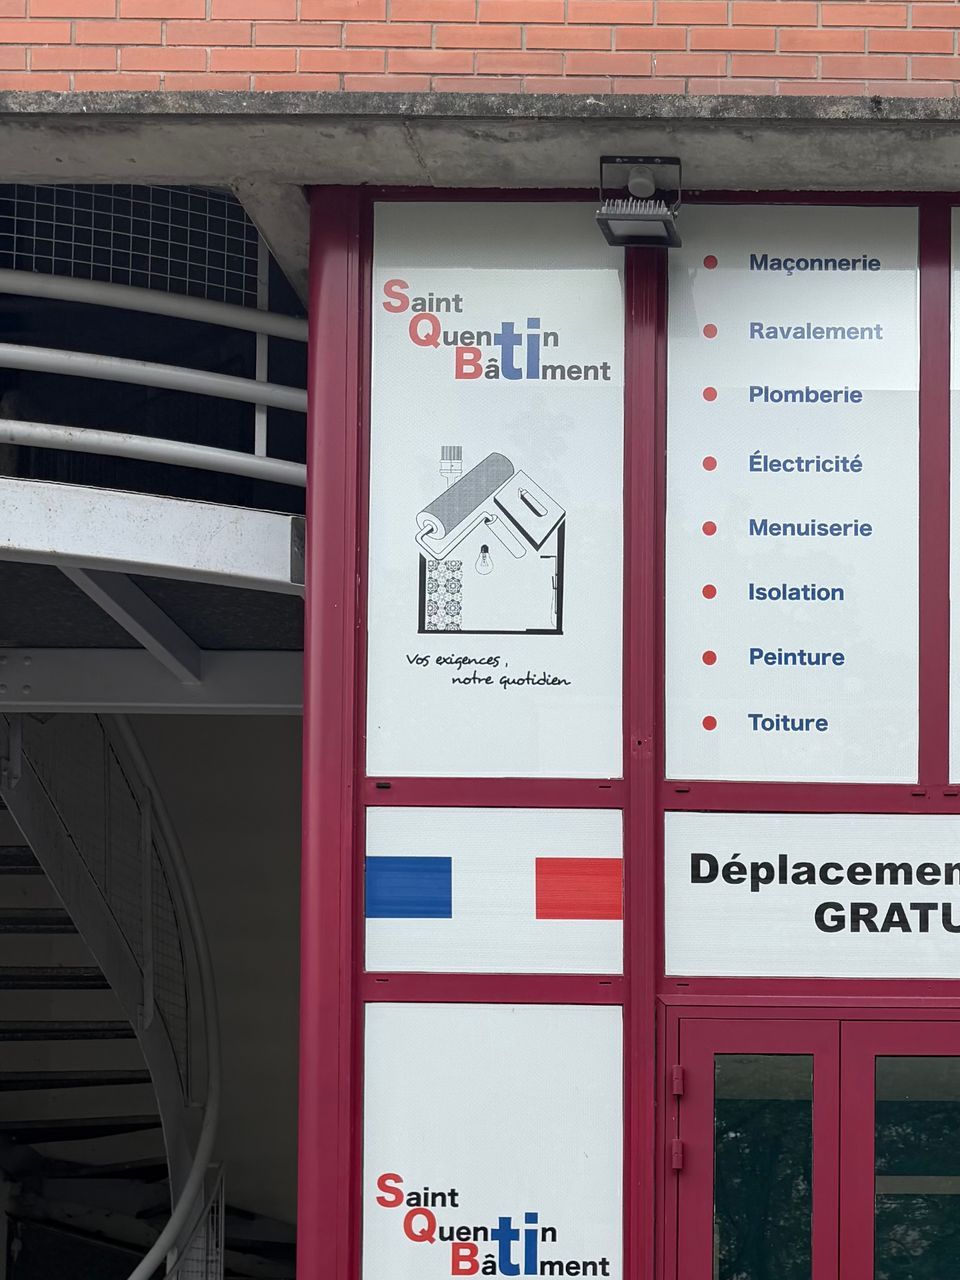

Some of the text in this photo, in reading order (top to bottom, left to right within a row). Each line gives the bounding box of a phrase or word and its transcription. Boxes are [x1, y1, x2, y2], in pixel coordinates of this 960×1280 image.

[750, 253, 881, 276] Maçonnerie
[382, 278, 463, 313] Saint
[750, 322, 882, 339] Ravalement
[408, 312, 559, 380] Quentin
[454, 317, 611, 381] Bâtiment
[750, 386, 862, 403] Plomberie
[750, 450, 862, 472] Électricité
[750, 519, 872, 536] Menuiserie
[750, 583, 844, 601] Isolation
[407, 654, 430, 667] Vos
[750, 648, 844, 665] Peinture
[452, 671, 571, 689] notre quotidien
[748, 714, 828, 731] Toiture
[375, 1173, 459, 1208] Saint
[403, 1207, 557, 1276] Quentin
[451, 1212, 610, 1276] Bâtiment
